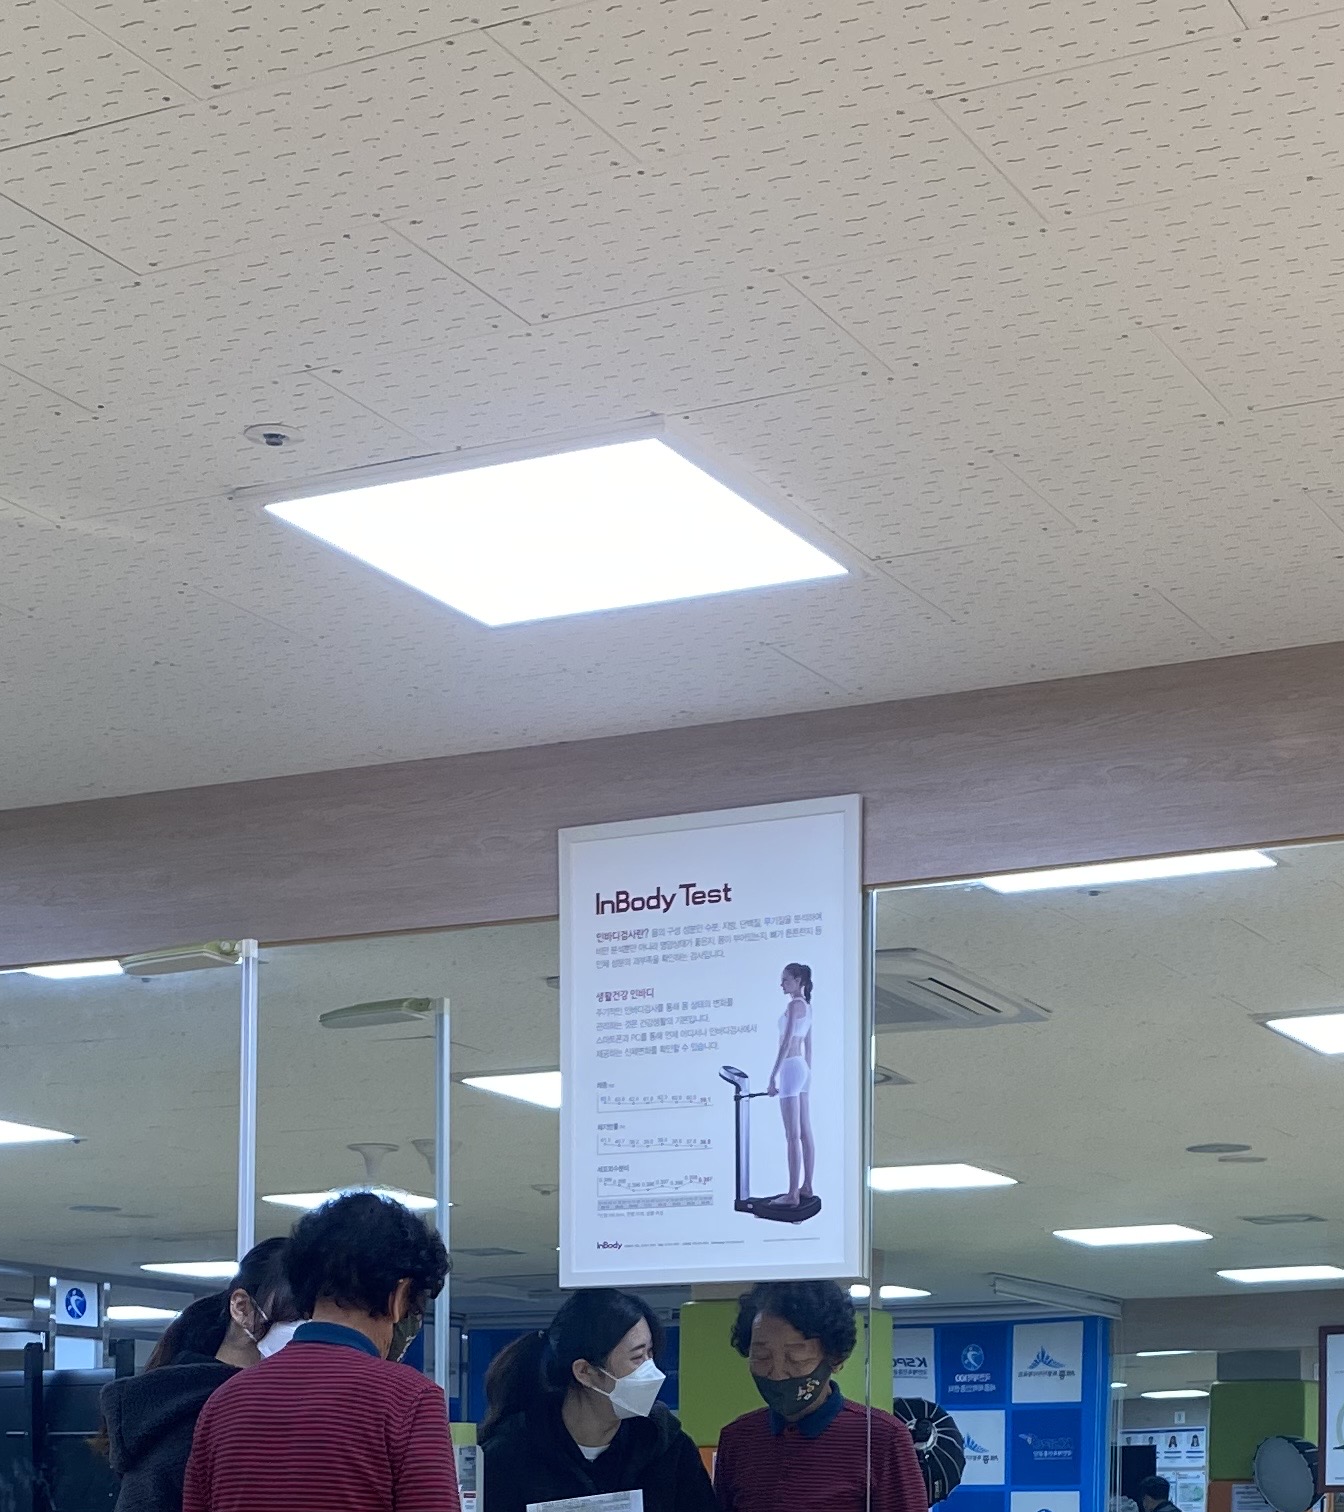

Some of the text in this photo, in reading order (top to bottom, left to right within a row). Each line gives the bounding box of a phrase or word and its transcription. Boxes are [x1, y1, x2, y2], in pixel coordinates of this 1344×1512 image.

[595, 882, 733, 916] InBody Test
[596, 1240, 623, 1250] InBody
